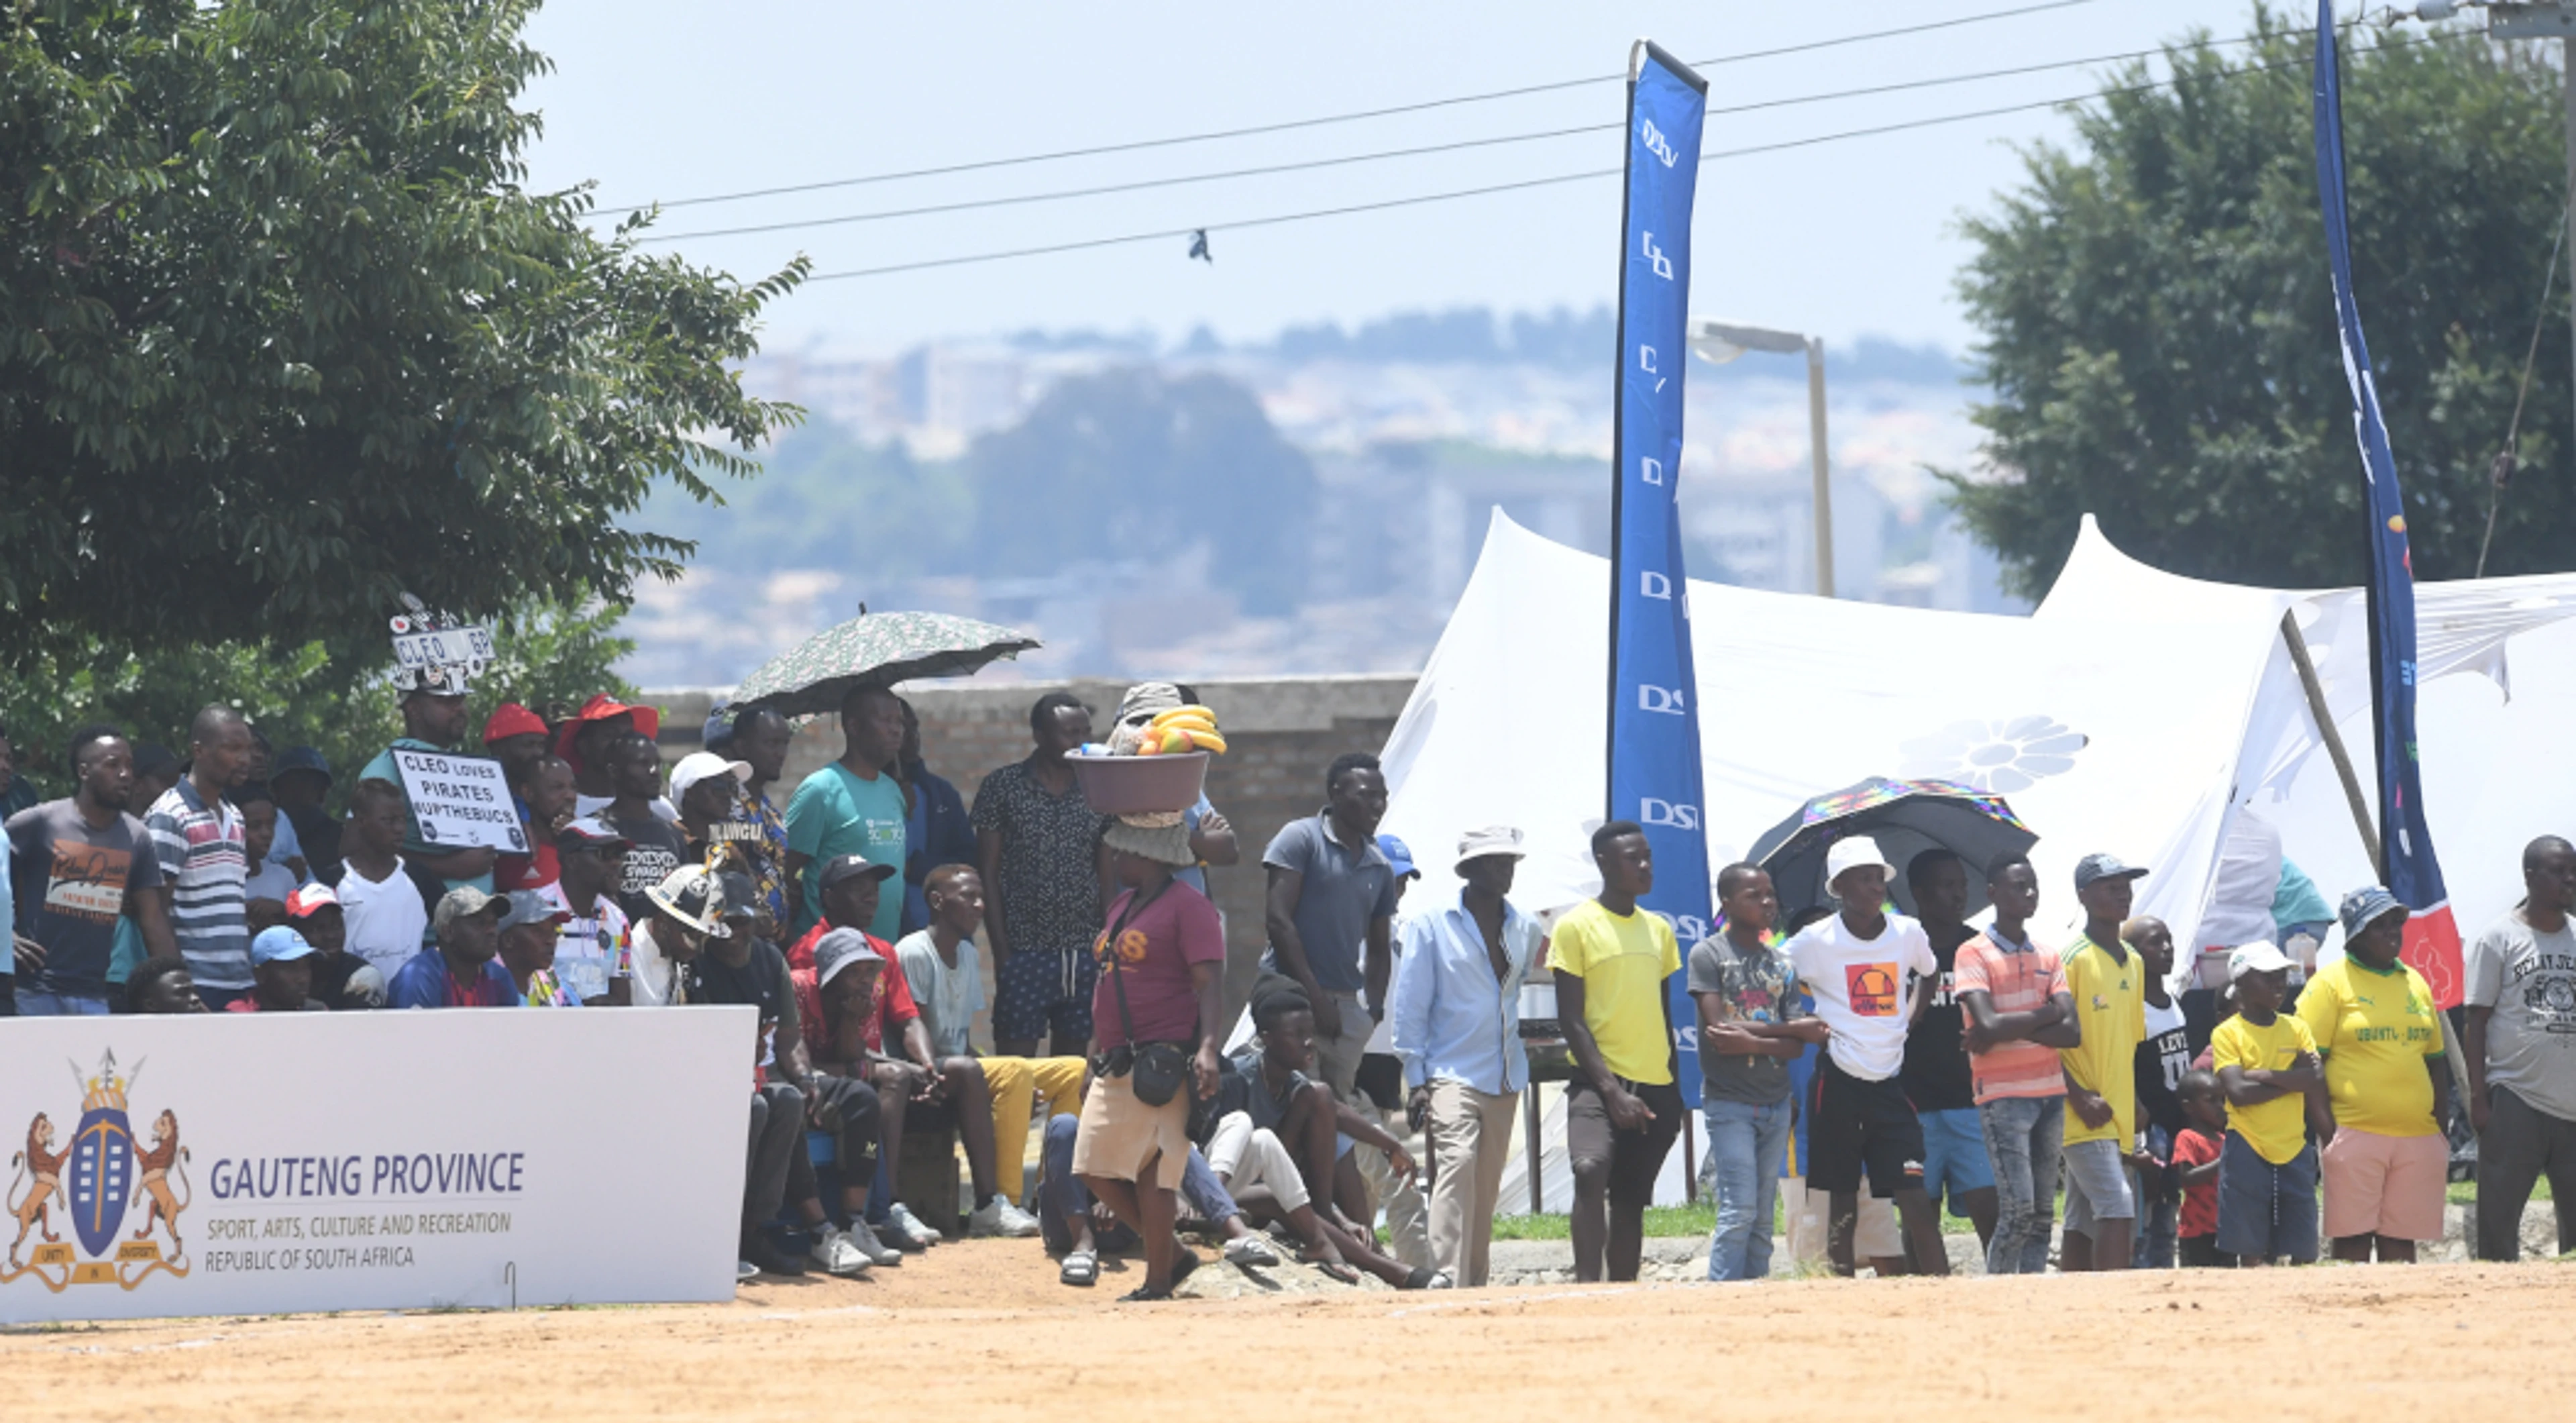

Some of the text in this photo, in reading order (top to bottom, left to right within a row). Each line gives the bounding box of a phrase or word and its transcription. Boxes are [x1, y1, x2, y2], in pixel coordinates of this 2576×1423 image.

[398, 637, 445, 664] CLEO
[405, 755, 496, 779] CLEO LOVES
[421, 780, 494, 802] PIRATES
[210, 1152, 525, 1199] GAUTENG PROVINCE
[207, 1212, 511, 1241] SPORT, ARTS, CULTURE AND RECREATION
[41, 1249, 64, 1261] UNITY
[205, 1246, 415, 1271] REPUBLIC OF SOUTH AFRICA
